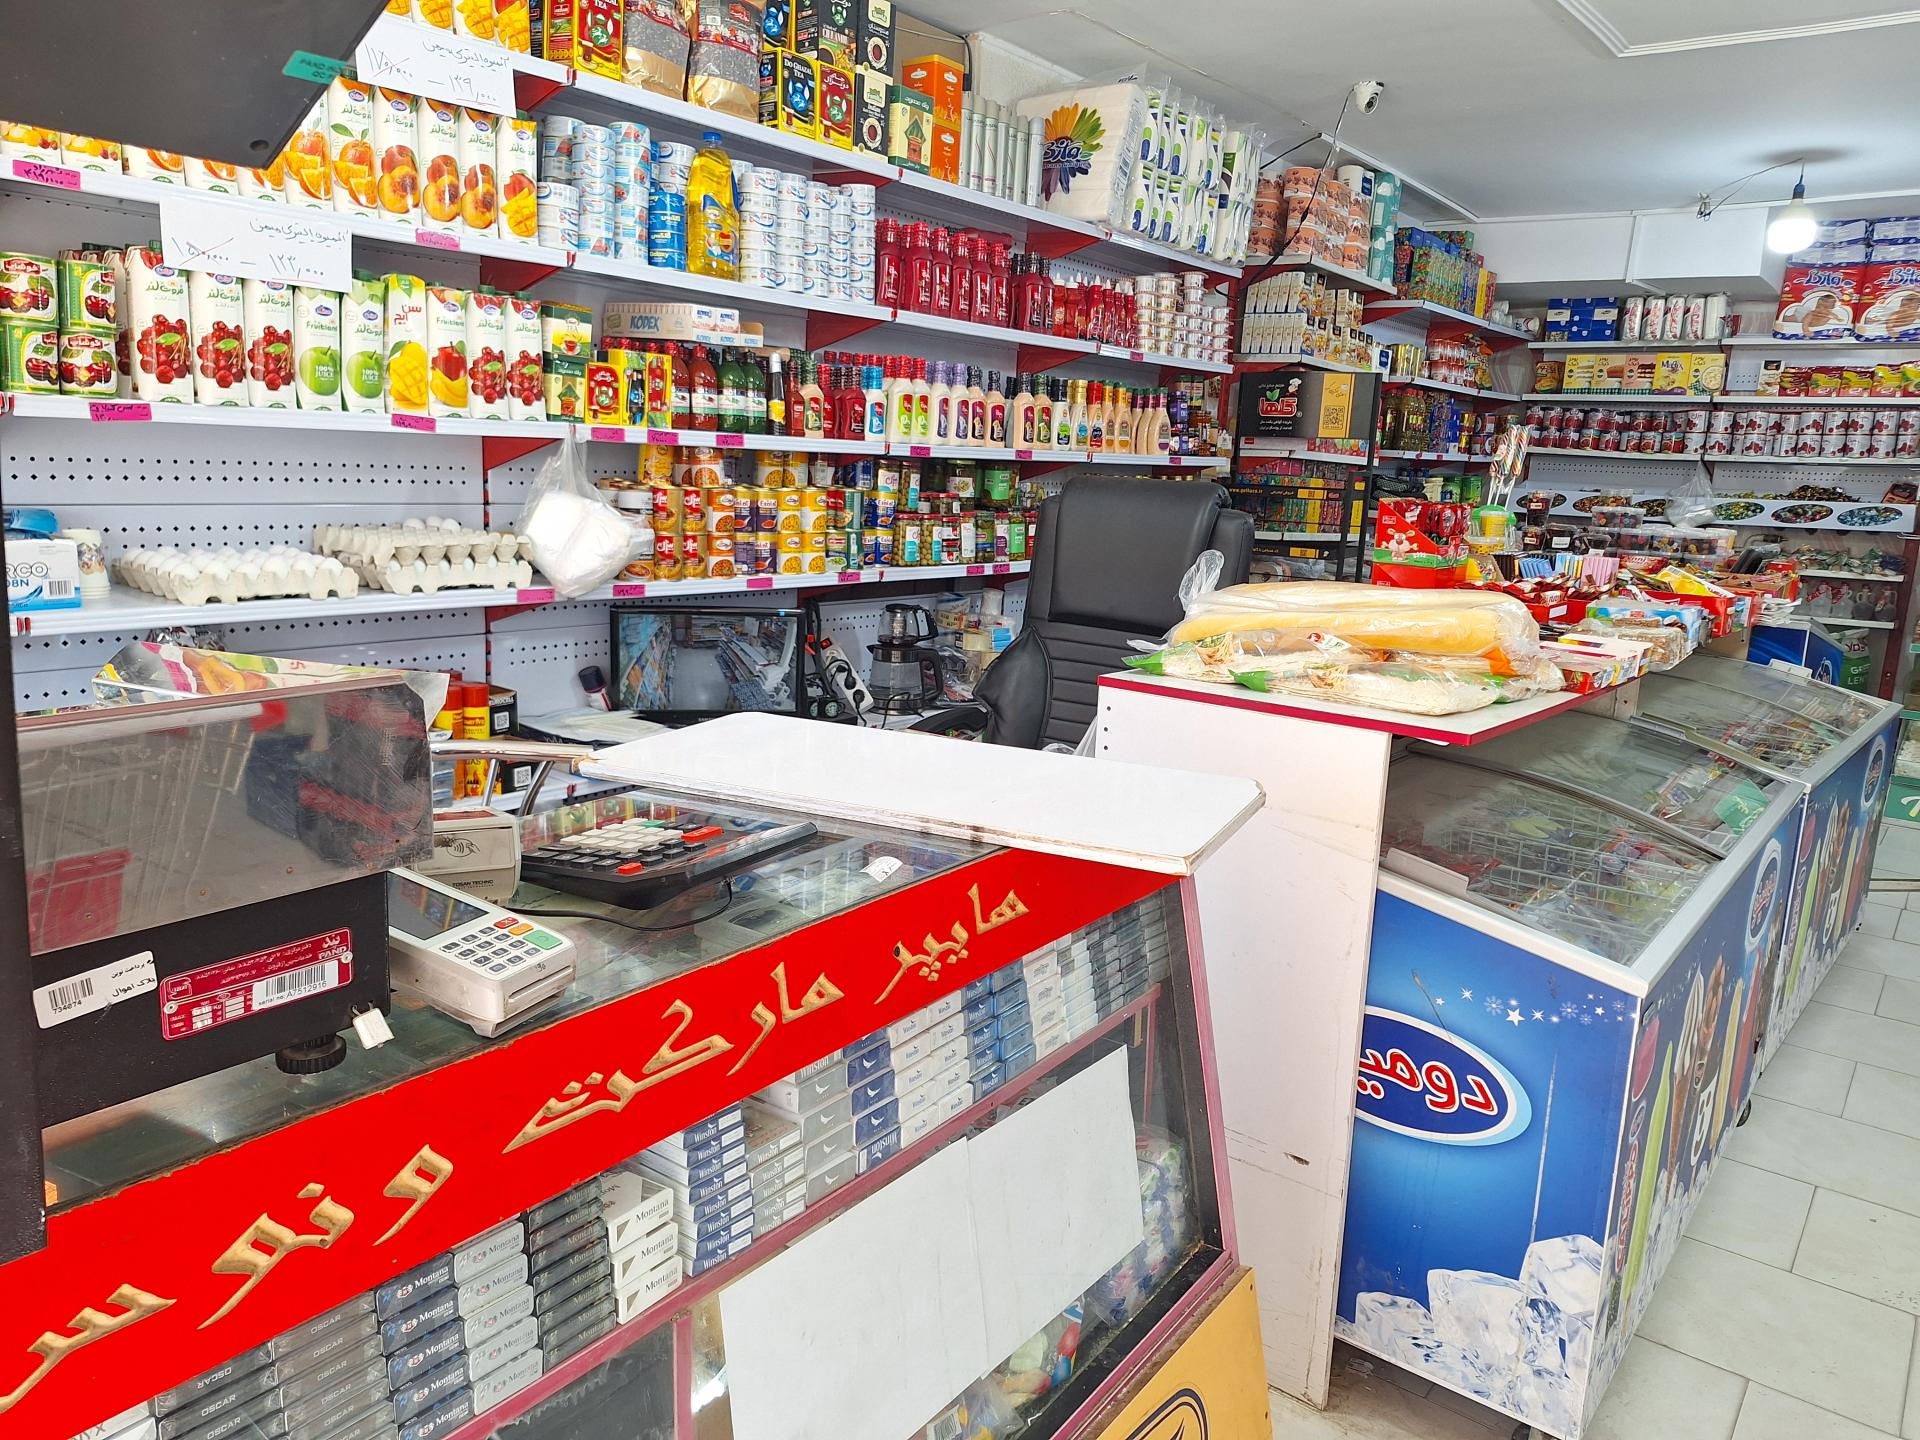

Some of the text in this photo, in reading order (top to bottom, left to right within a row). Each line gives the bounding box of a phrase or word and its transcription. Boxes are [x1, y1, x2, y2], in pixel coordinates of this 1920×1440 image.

[630, 315, 661, 331] KODEX
[319, 945, 348, 961] PAND
[874, 882, 1030, 1005] هایپر
[286, 980, 328, 1000] A7512916
[502, 960, 845, 1154] مارکت
[1357, 1048, 1499, 1116] دومی
[694, 1126, 718, 1144] Winston
[697, 1143, 721, 1161] Winston
[698, 1160, 722, 1179] Winston
[700, 1179, 723, 1198] Winston
[635, 1199, 670, 1224] Montana
[704, 1197, 728, 1216] Winston
[707, 1214, 731, 1233] Winston
[641, 1233, 675, 1260] Montana
[706, 1232, 730, 1252] Winston
[703, 1251, 728, 1270] Winston
[414, 1266, 449, 1289] Montana
[645, 1266, 679, 1294] Montana
[419, 1299, 454, 1323] Montana
[311, 1314, 341, 1335] OSCAR
[313, 1337, 344, 1358] OSCAR
[424, 1333, 459, 1357] Montana
[197, 1366, 233, 1389] OSCAR
[317, 1360, 348, 1382] OSCAR
[430, 1367, 464, 1392] Montana
[201, 1394, 237, 1417] OSCAR
[321, 1383, 352, 1406] OSCAR
[323, 1405, 355, 1427] OSCAR
[436, 1401, 469, 1427] Montana
[207, 1416, 242, 1440] OSCAR
